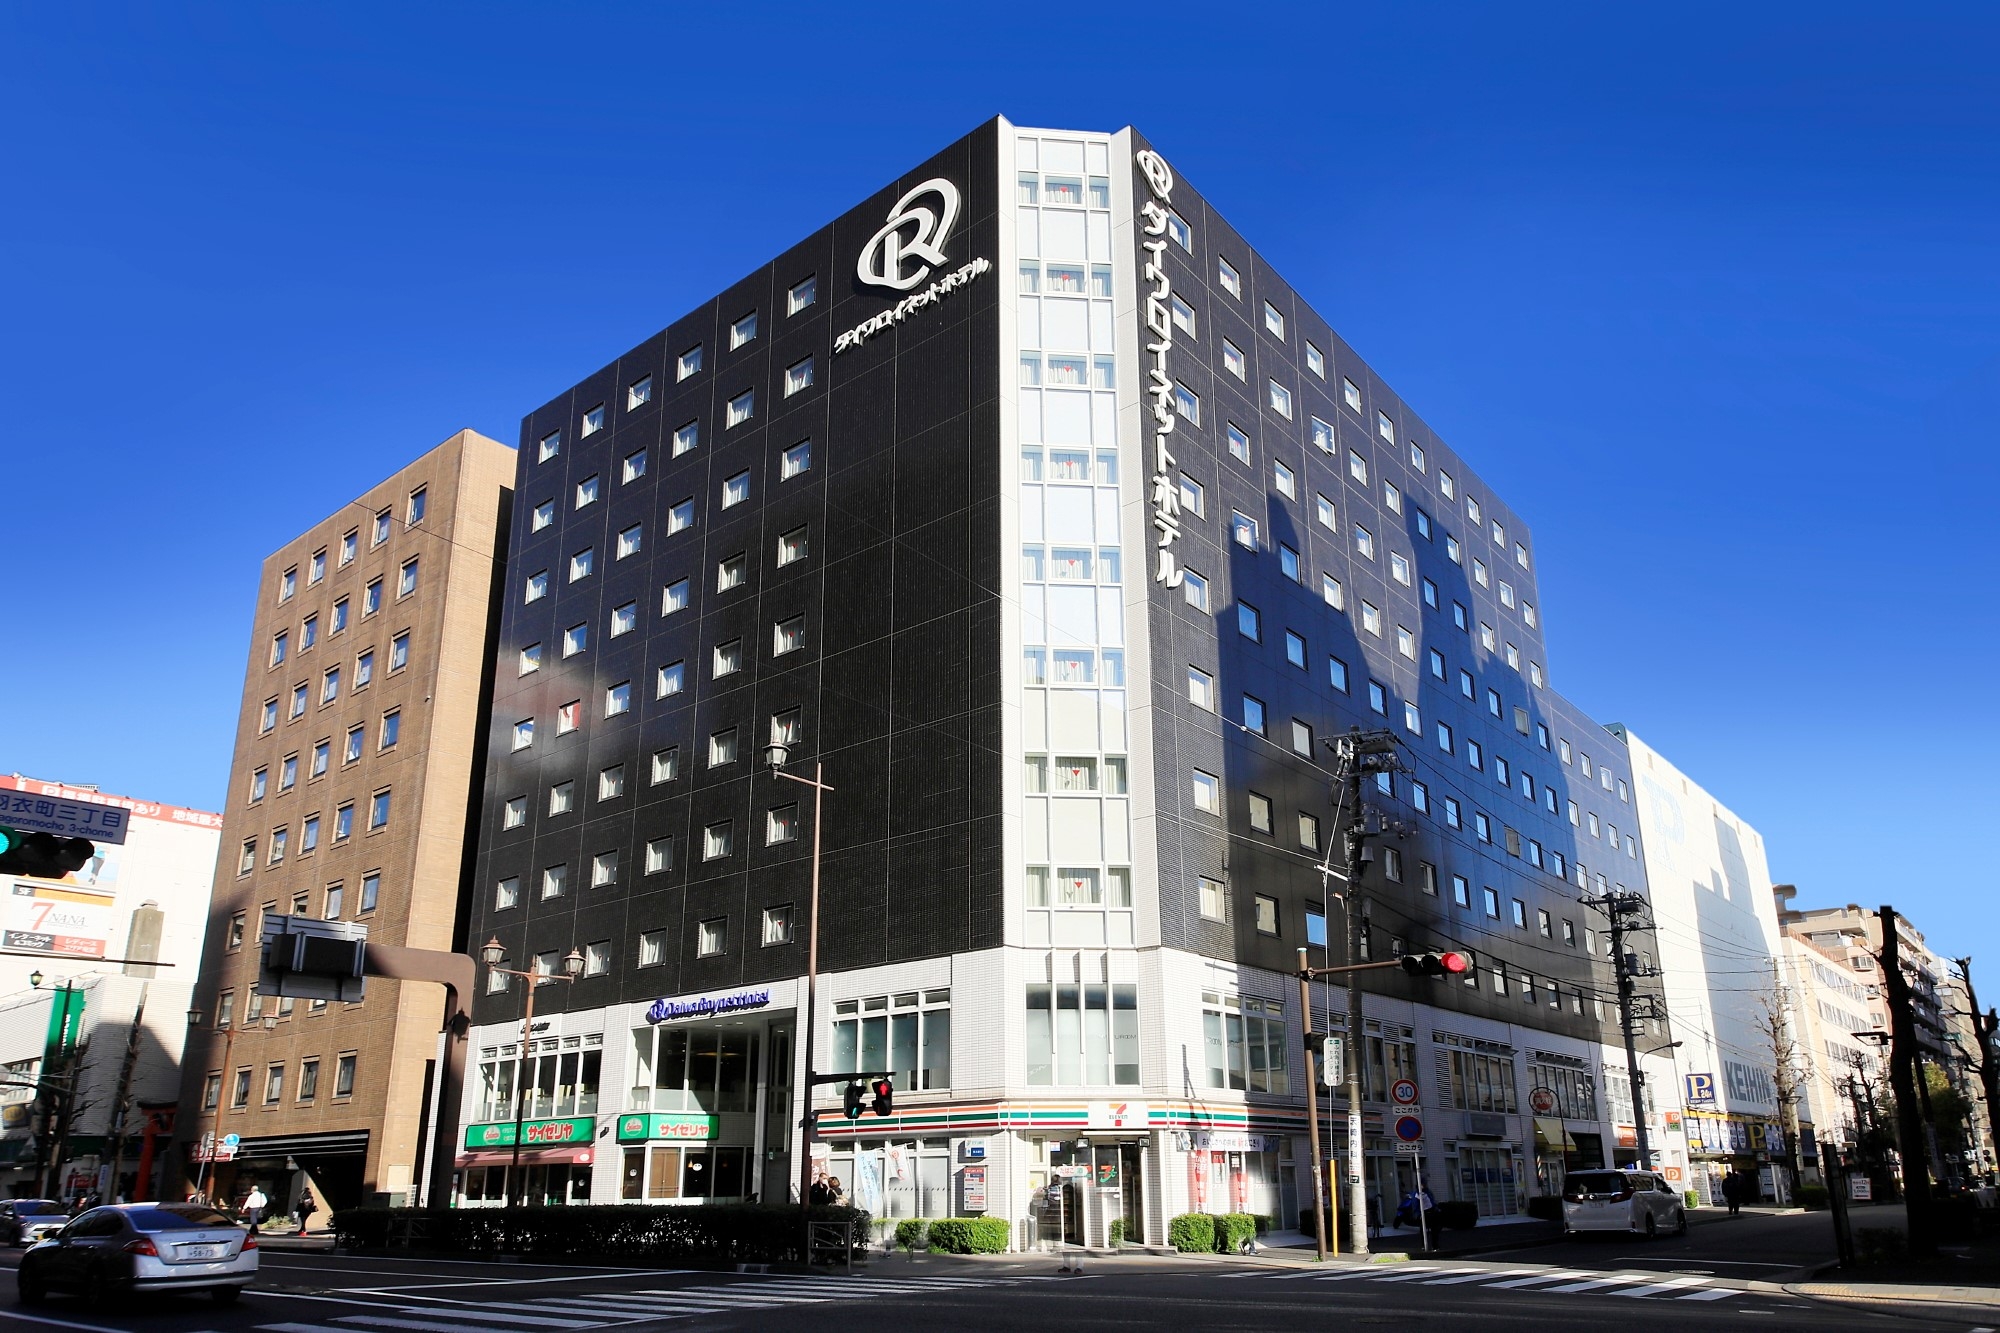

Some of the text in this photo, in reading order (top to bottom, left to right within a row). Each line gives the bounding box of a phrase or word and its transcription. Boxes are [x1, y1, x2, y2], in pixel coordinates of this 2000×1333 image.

[833, 256, 992, 354] ダイワロイネットホテル
[1141, 200, 1184, 589] ダイワロイネットホテル
[69, 823, 114, 838] 3-chome
[1398, 1086, 1413, 1098] 30
[1687, 1075, 1711, 1099] P
[1724, 1060, 1772, 1104] KEIHIN
[528, 1122, 573, 1142] サイゼリヤ
[660, 1122, 710, 1136] サイゼリヤ
